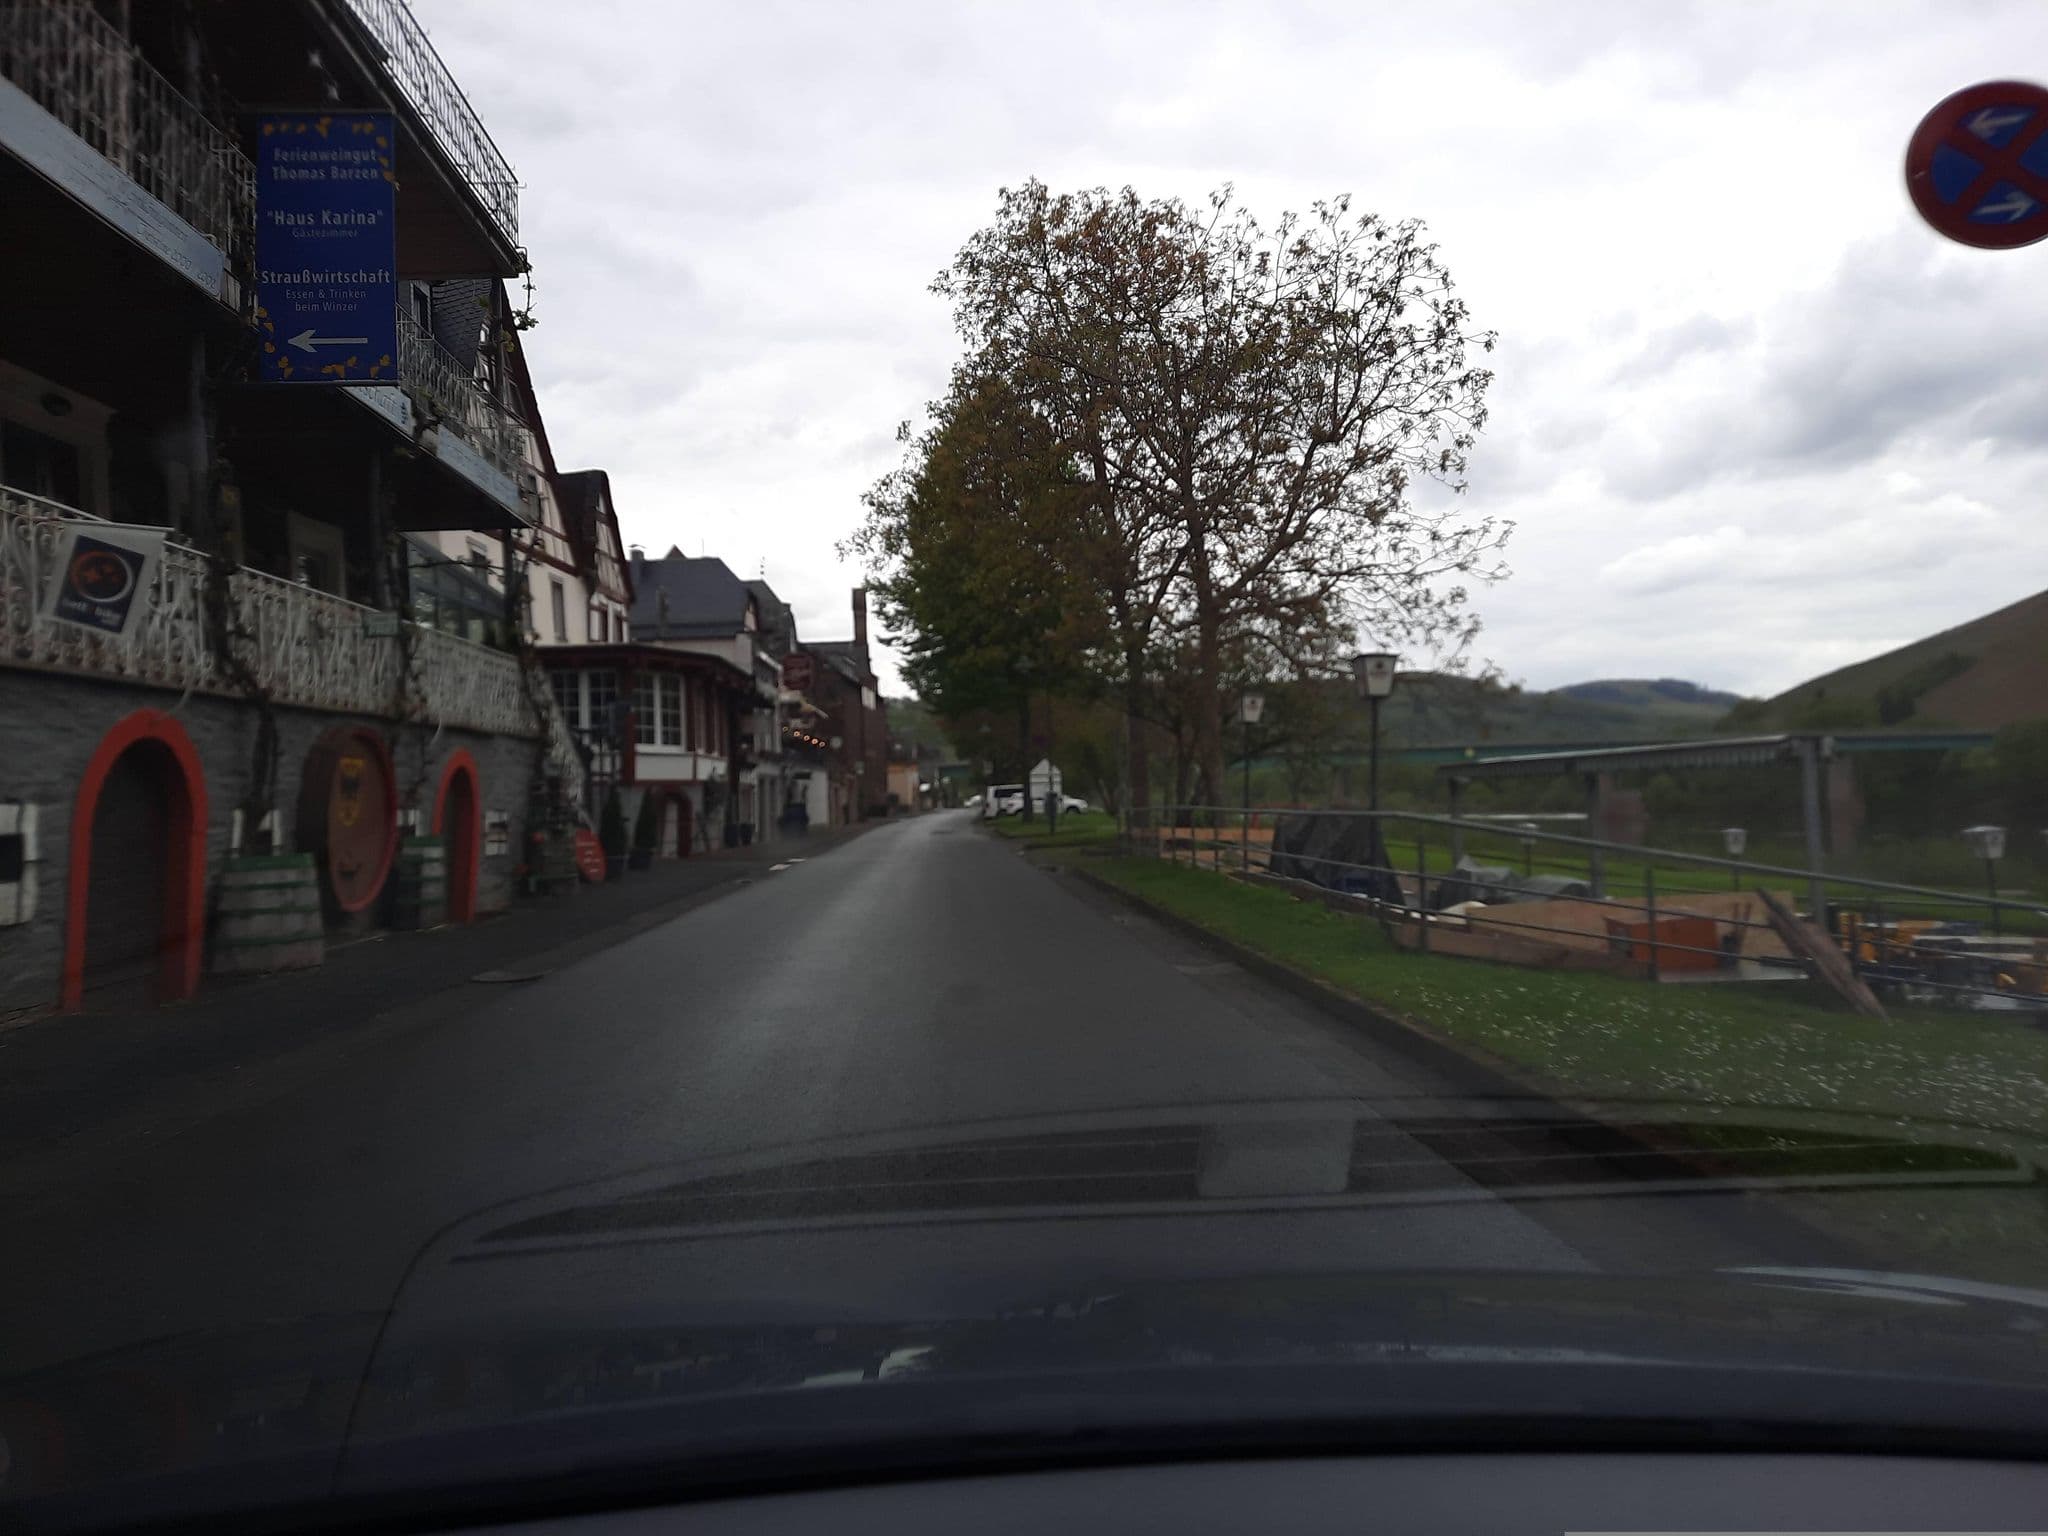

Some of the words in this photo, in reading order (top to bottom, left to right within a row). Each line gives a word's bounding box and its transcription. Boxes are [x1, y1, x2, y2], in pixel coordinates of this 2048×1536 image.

[271, 166, 326, 180] Thomas
[331, 166, 378, 180] Barzen
[262, 269, 391, 284] Straußwirtschaft
[286, 289, 314, 299] Essen
[318, 289, 326, 299] &
[329, 288, 367, 299] Trinken
[295, 301, 320, 312] beim
[323, 301, 358, 312] Winzer
